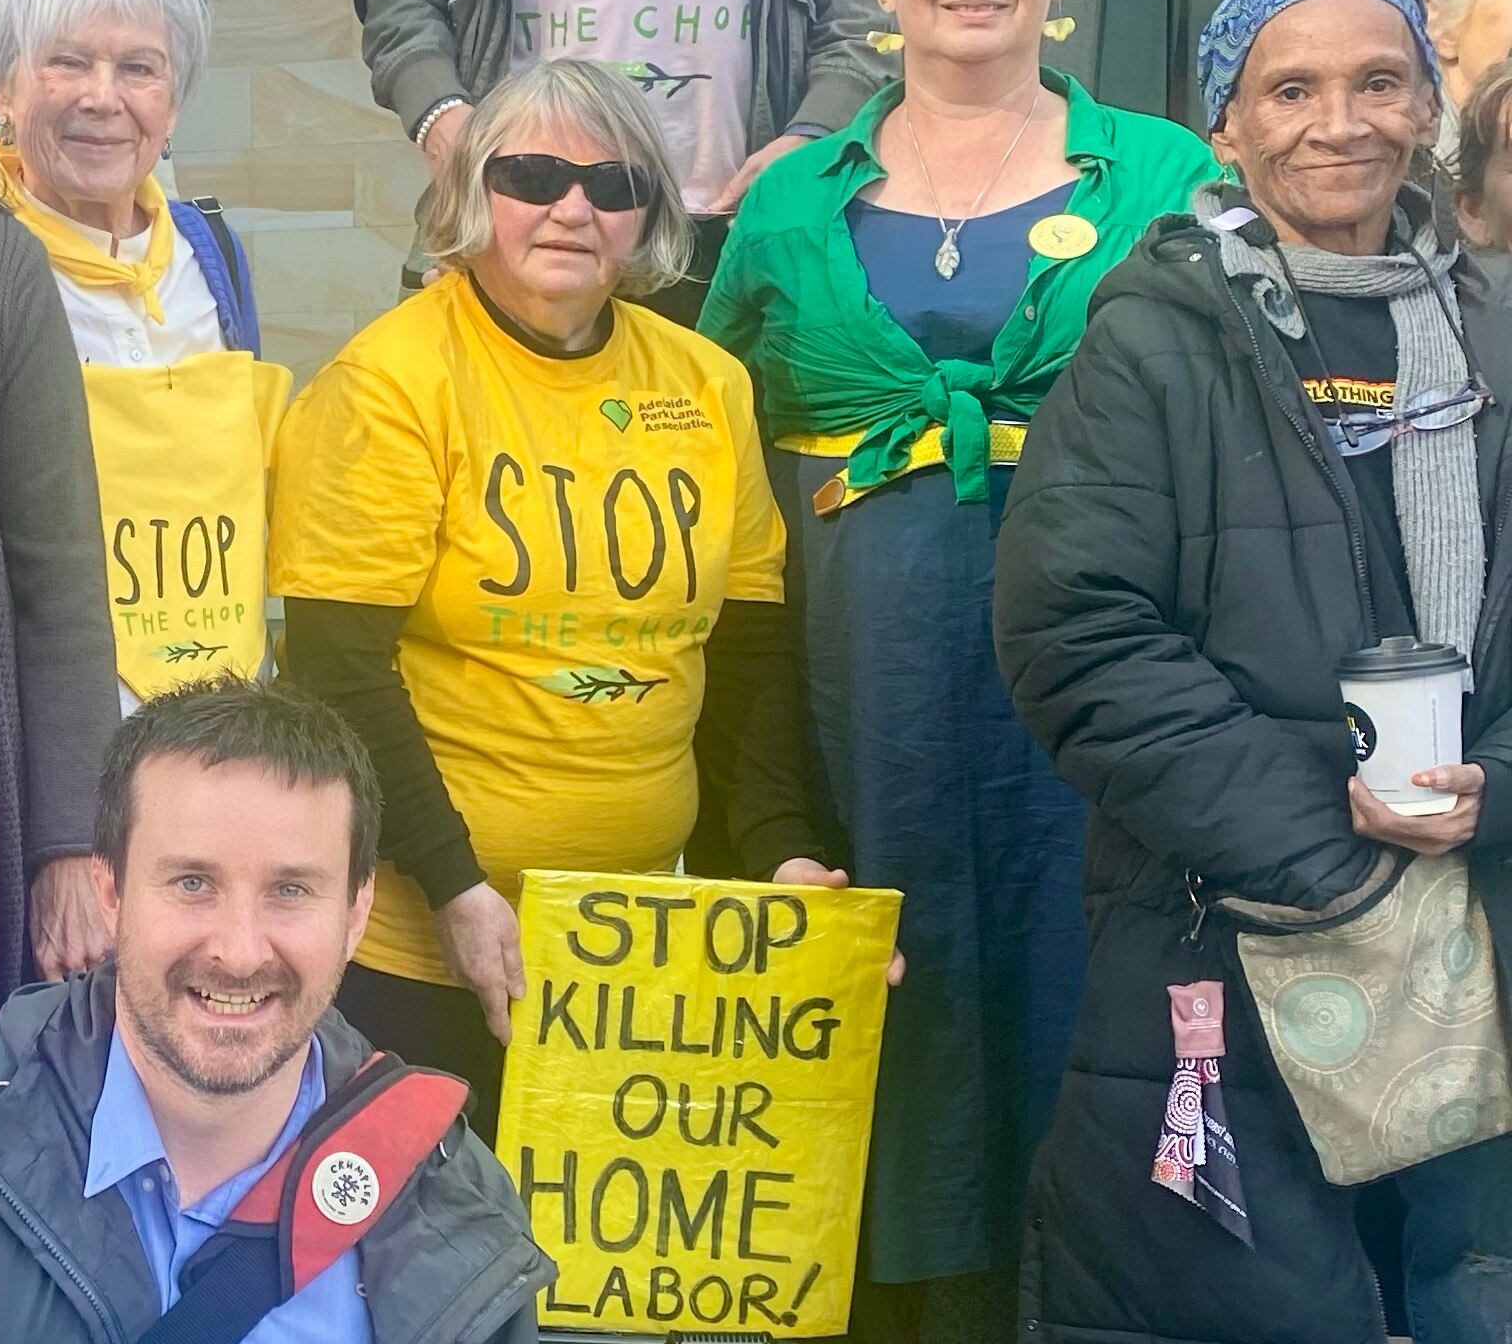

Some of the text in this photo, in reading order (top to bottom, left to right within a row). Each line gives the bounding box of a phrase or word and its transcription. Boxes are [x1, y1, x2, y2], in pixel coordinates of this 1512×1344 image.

[515, 6, 598, 52] THE
[638, 397, 692, 412] Adelaide
[1306, 386, 1394, 404] LOTHING
[113, 514, 236, 606] STOP
[479, 452, 701, 603] STOP
[119, 603, 245, 636] THE CHOP
[479, 606, 709, 654] THE CHOP
[566, 890, 808, 976] STOP
[538, 979, 841, 1060] KILLING
[612, 1073, 781, 1149] OUR
[520, 1146, 795, 1264] HOME
[545, 1263, 822, 1327] LABOR!
